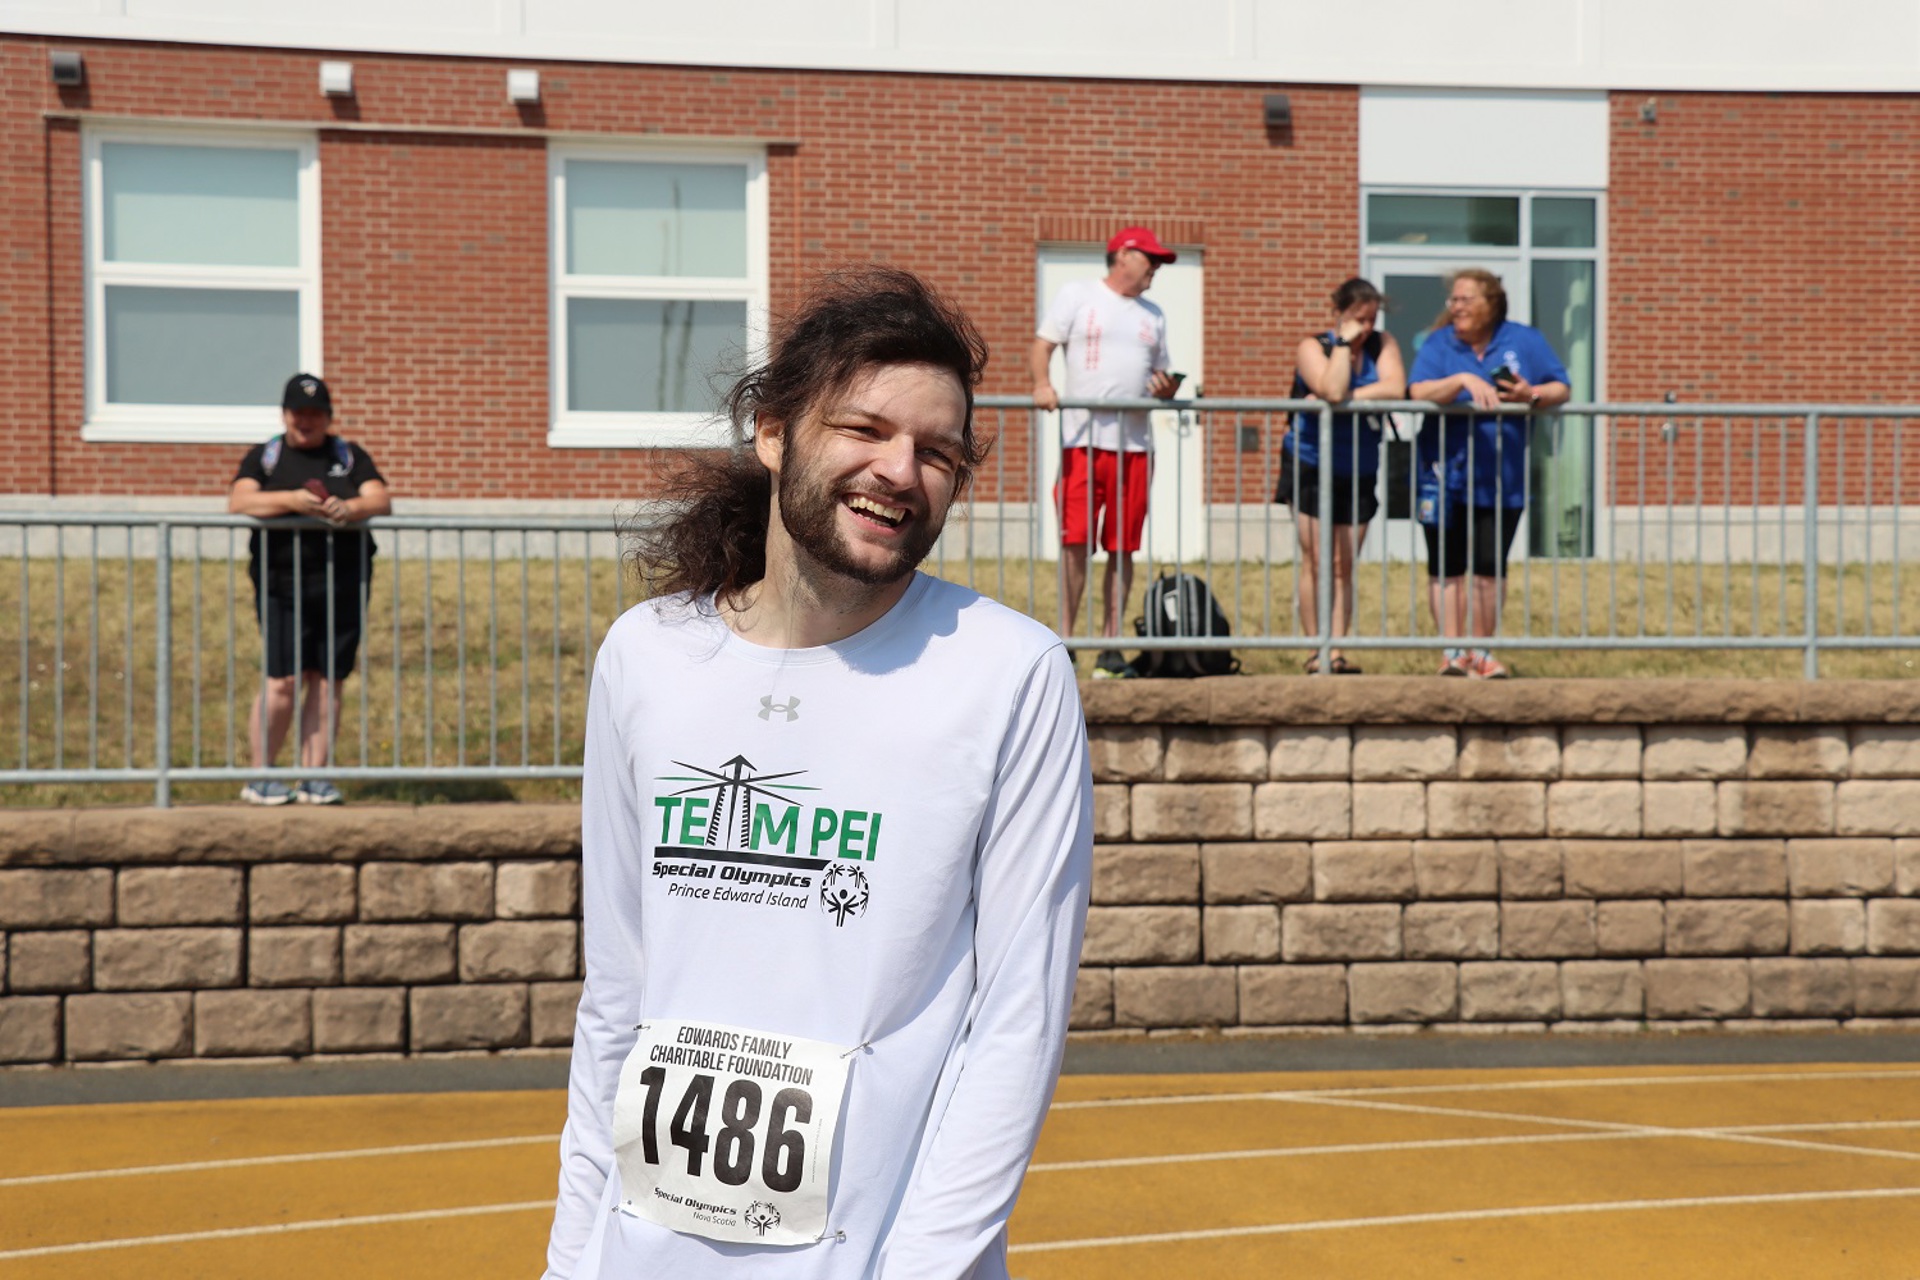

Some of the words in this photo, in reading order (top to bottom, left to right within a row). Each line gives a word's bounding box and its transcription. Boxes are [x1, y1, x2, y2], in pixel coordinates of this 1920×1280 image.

[809, 807, 882, 861] PEI
[652, 861, 715, 878] Special
[720, 865, 811, 887] Olympics
[668, 882, 709, 898] Prince
[712, 886, 764, 903] Edward
[766, 891, 809, 908] Island
[676, 1026, 739, 1050] EDWARDS
[741, 1035, 792, 1059] FAMILY
[649, 1044, 725, 1070] CHARITABLE
[726, 1055, 813, 1085] FOUNDATION
[639, 1065, 812, 1192] 1486
[653, 1187, 683, 1203] Special
[684, 1198, 737, 1215] Olympics
[693, 1211, 710, 1222] Nova
[712, 1215, 736, 1226] Scotia
